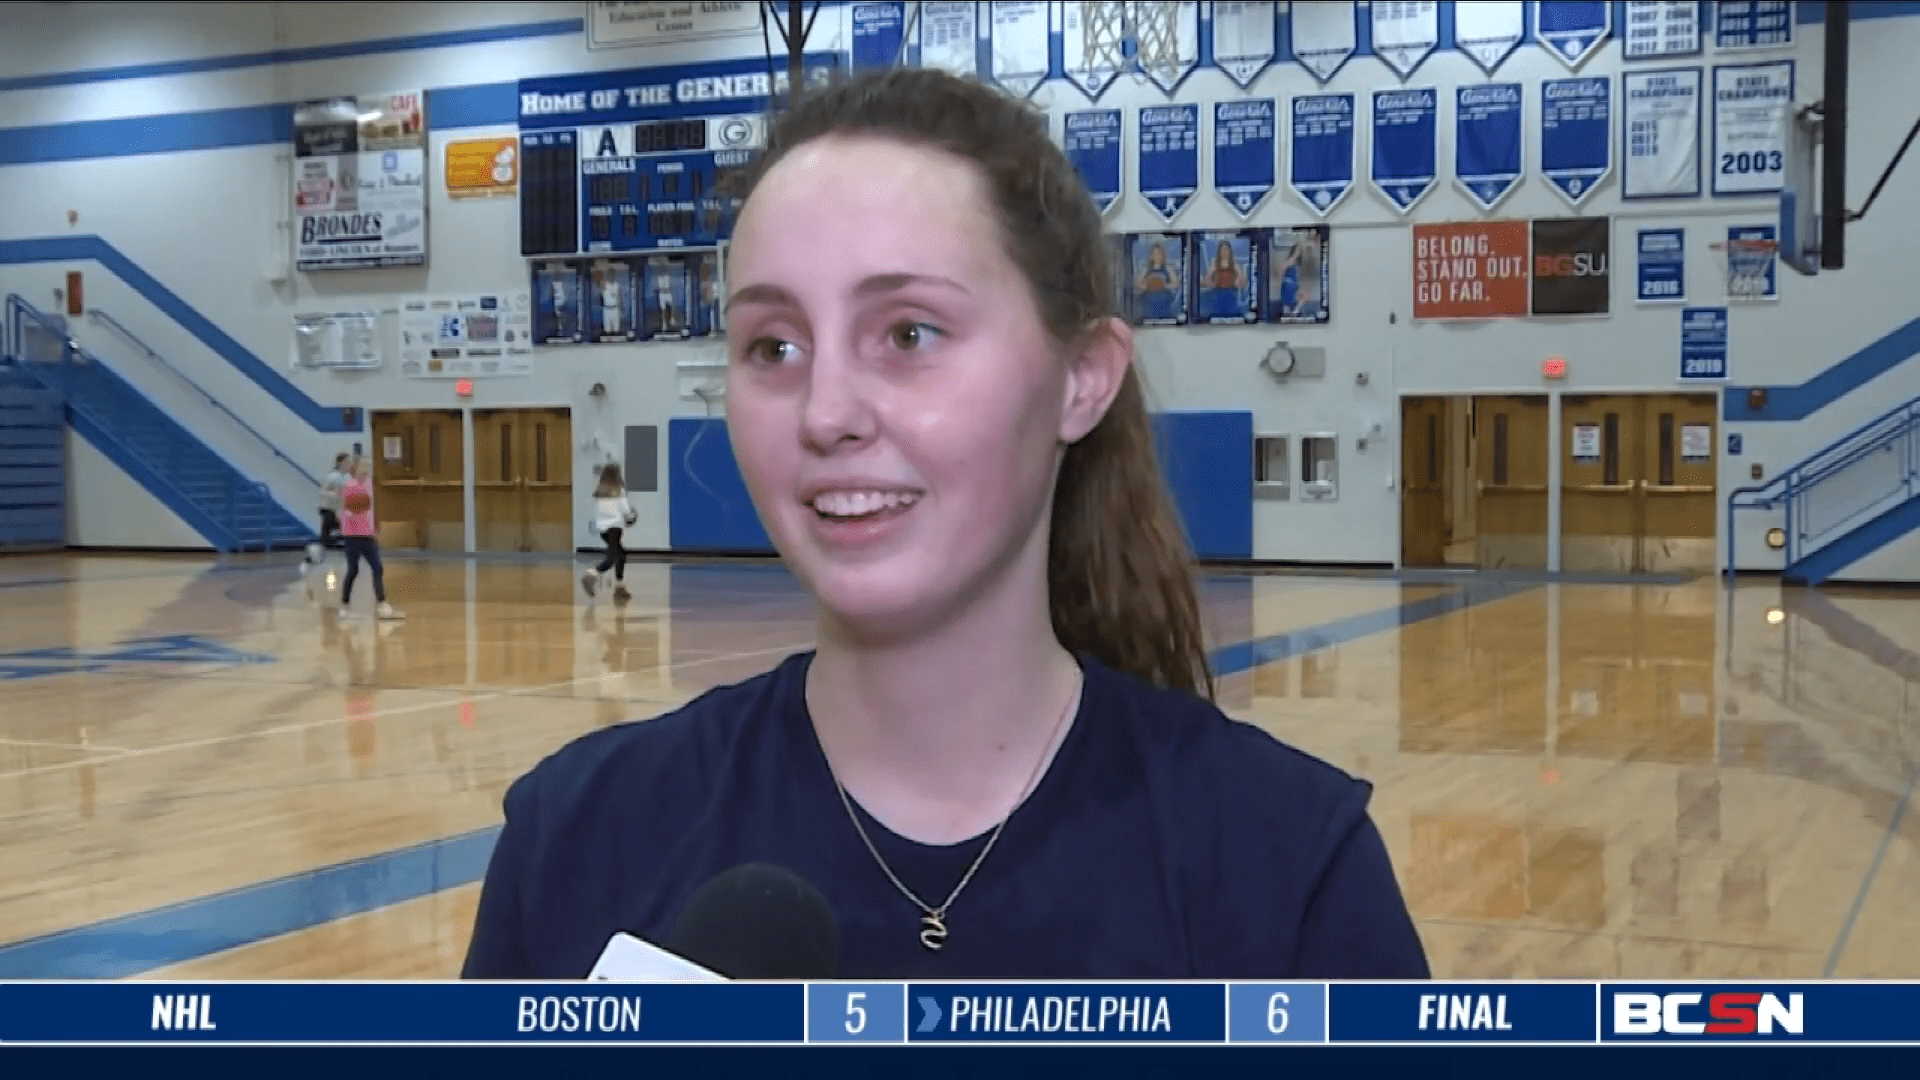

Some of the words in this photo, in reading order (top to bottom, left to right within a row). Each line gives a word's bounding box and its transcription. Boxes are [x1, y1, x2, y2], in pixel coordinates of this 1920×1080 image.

[591, 89, 620, 109] OF
[625, 84, 672, 107] THE
[1721, 150, 1783, 174] 2003
[1418, 235, 1496, 258] BELONG.
[1418, 258, 1477, 281] STAND
[1487, 256, 1528, 278] OUT.
[1418, 282, 1441, 303] GO
[1450, 280, 1491, 302] FAR.
